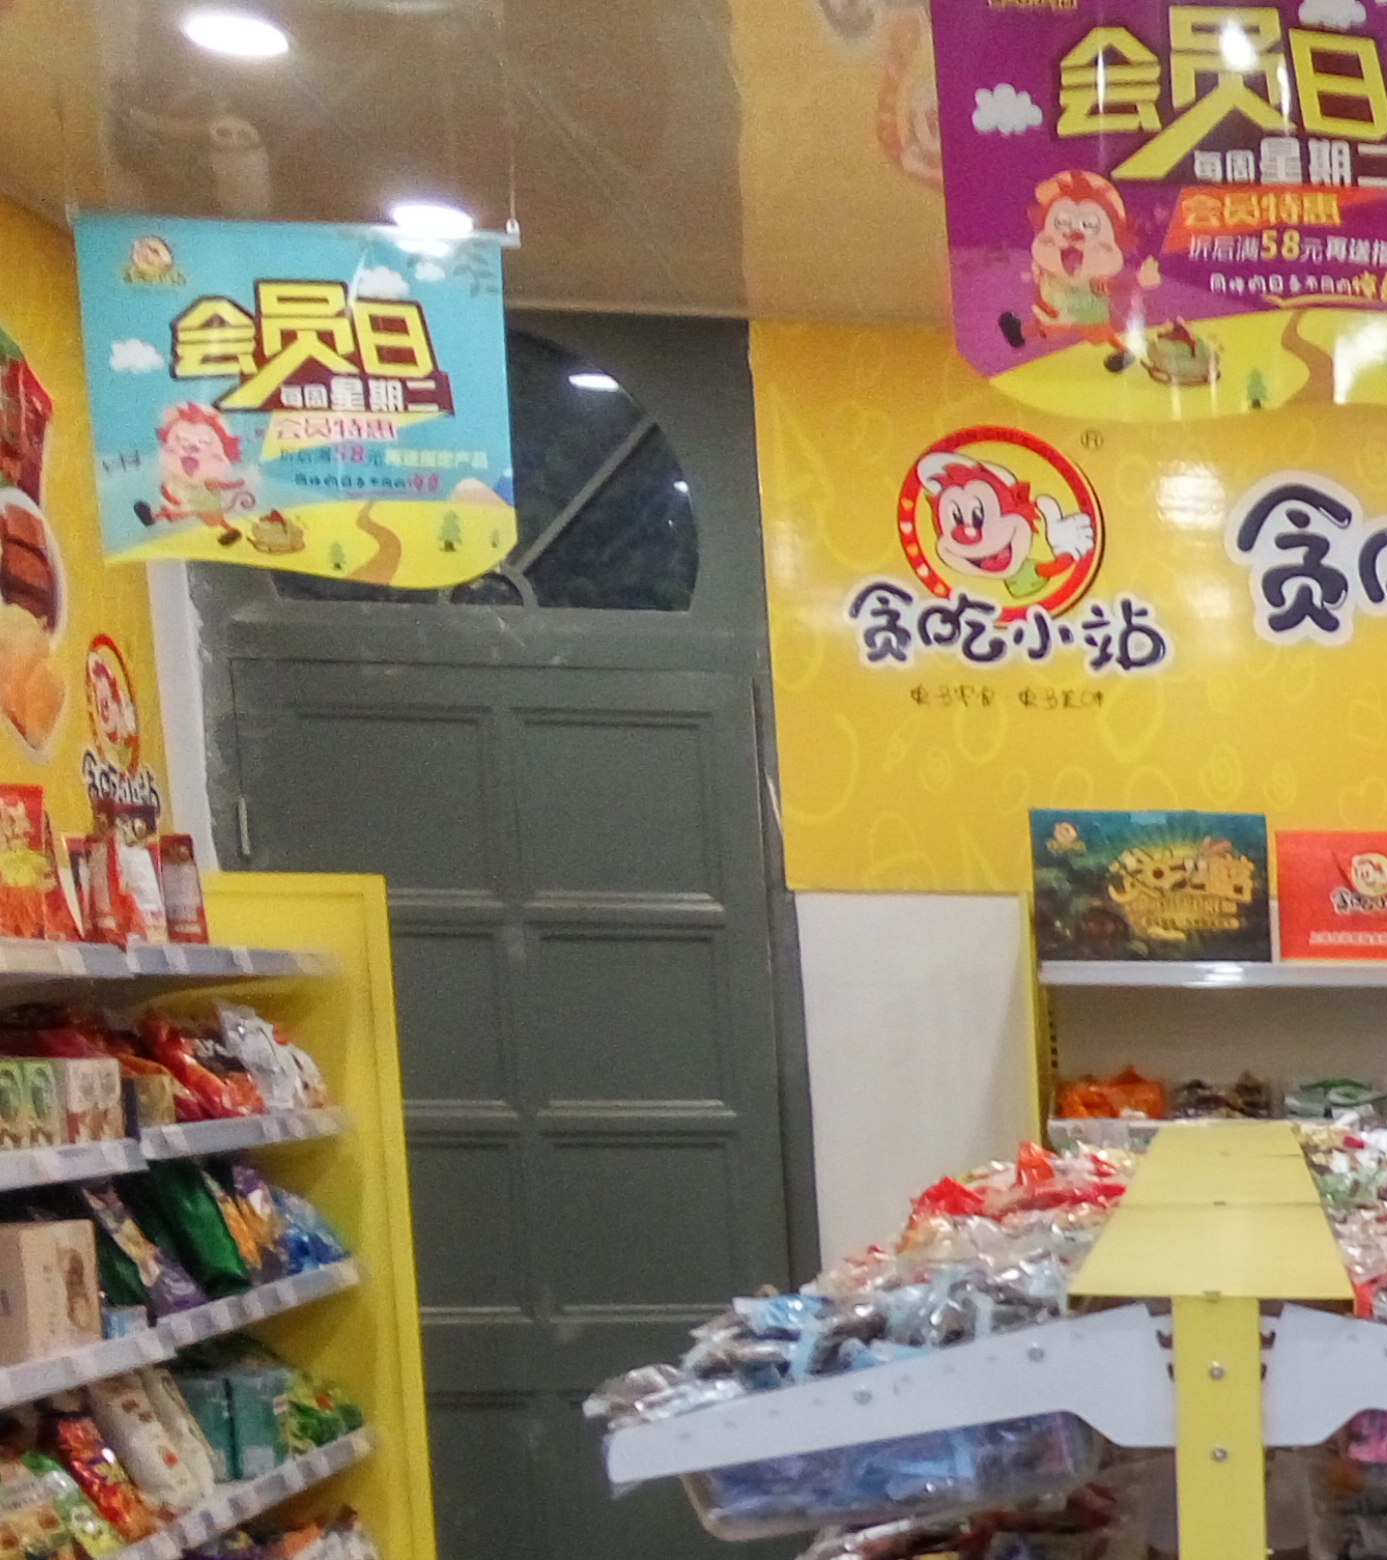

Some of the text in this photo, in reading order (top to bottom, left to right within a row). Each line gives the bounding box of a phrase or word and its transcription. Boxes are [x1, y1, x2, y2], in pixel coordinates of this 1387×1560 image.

[172, 280, 434, 409] 会员日
[850, 582, 1165, 671] 贪吃小站
